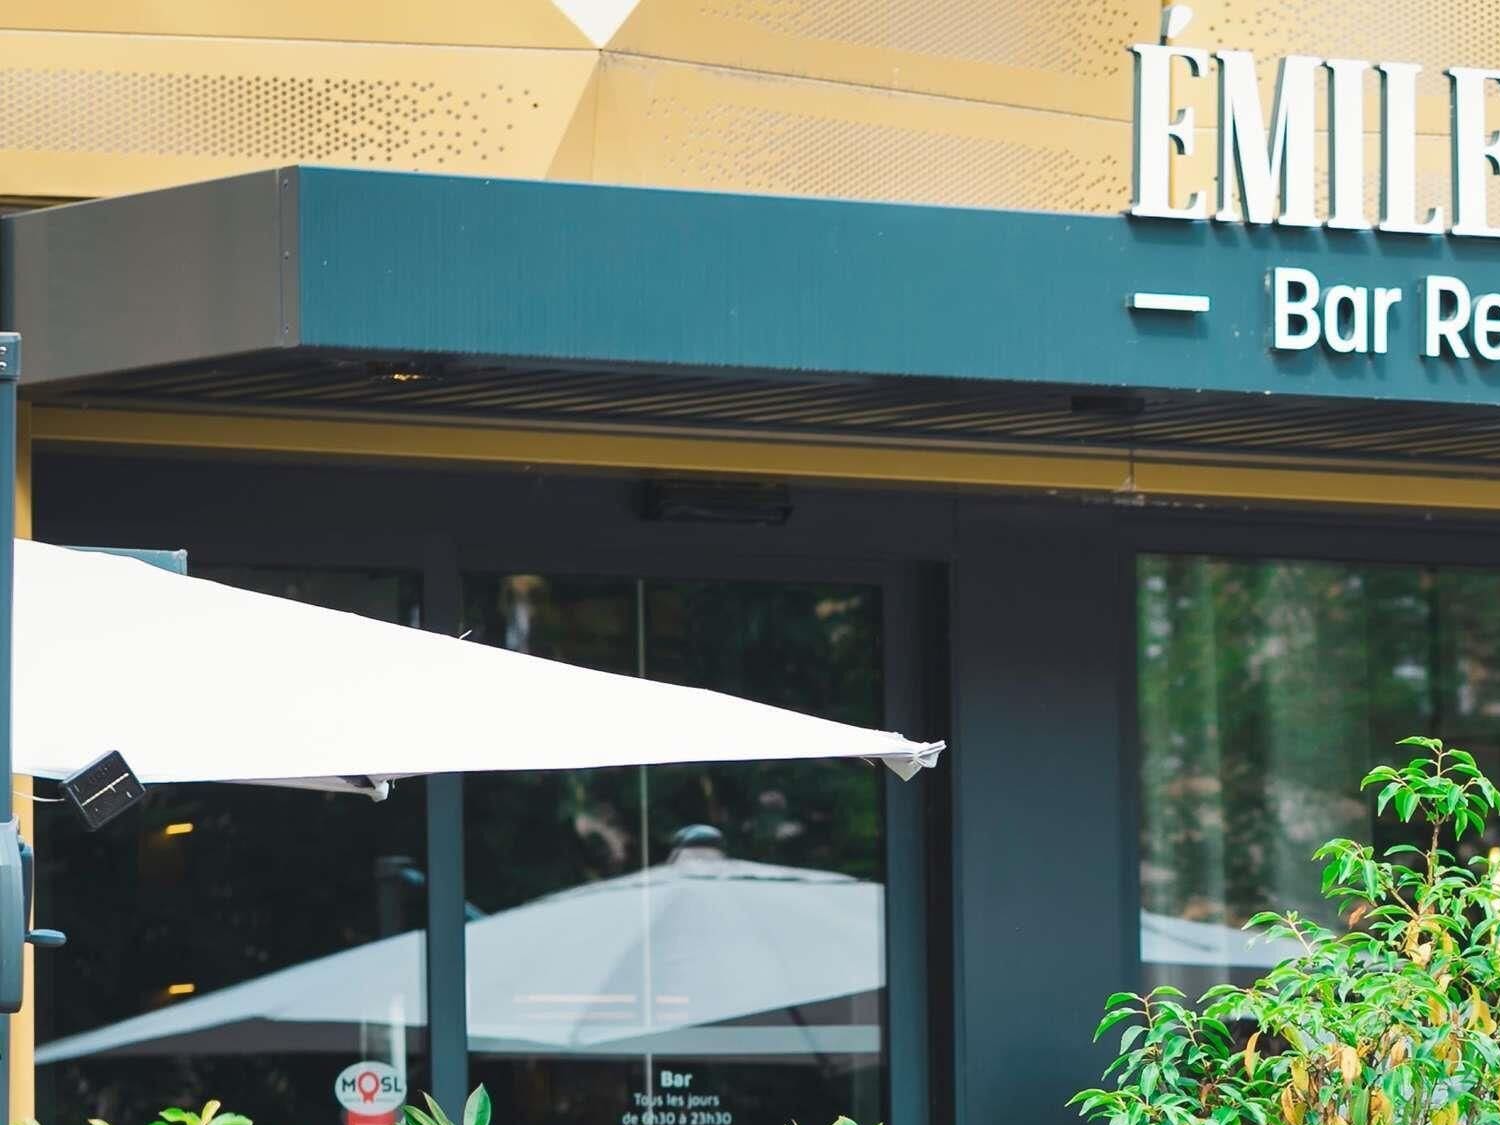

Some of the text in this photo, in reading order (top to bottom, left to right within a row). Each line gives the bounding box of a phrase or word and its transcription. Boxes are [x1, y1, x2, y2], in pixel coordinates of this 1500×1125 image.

[1270, 266, 1402, 354] Bar
[660, 1070, 693, 1088] Bar
[634, 1093, 720, 1109] Tous les jours
[622, 1112, 638, 1125] de
[690, 1112, 732, 1125] 23h30
